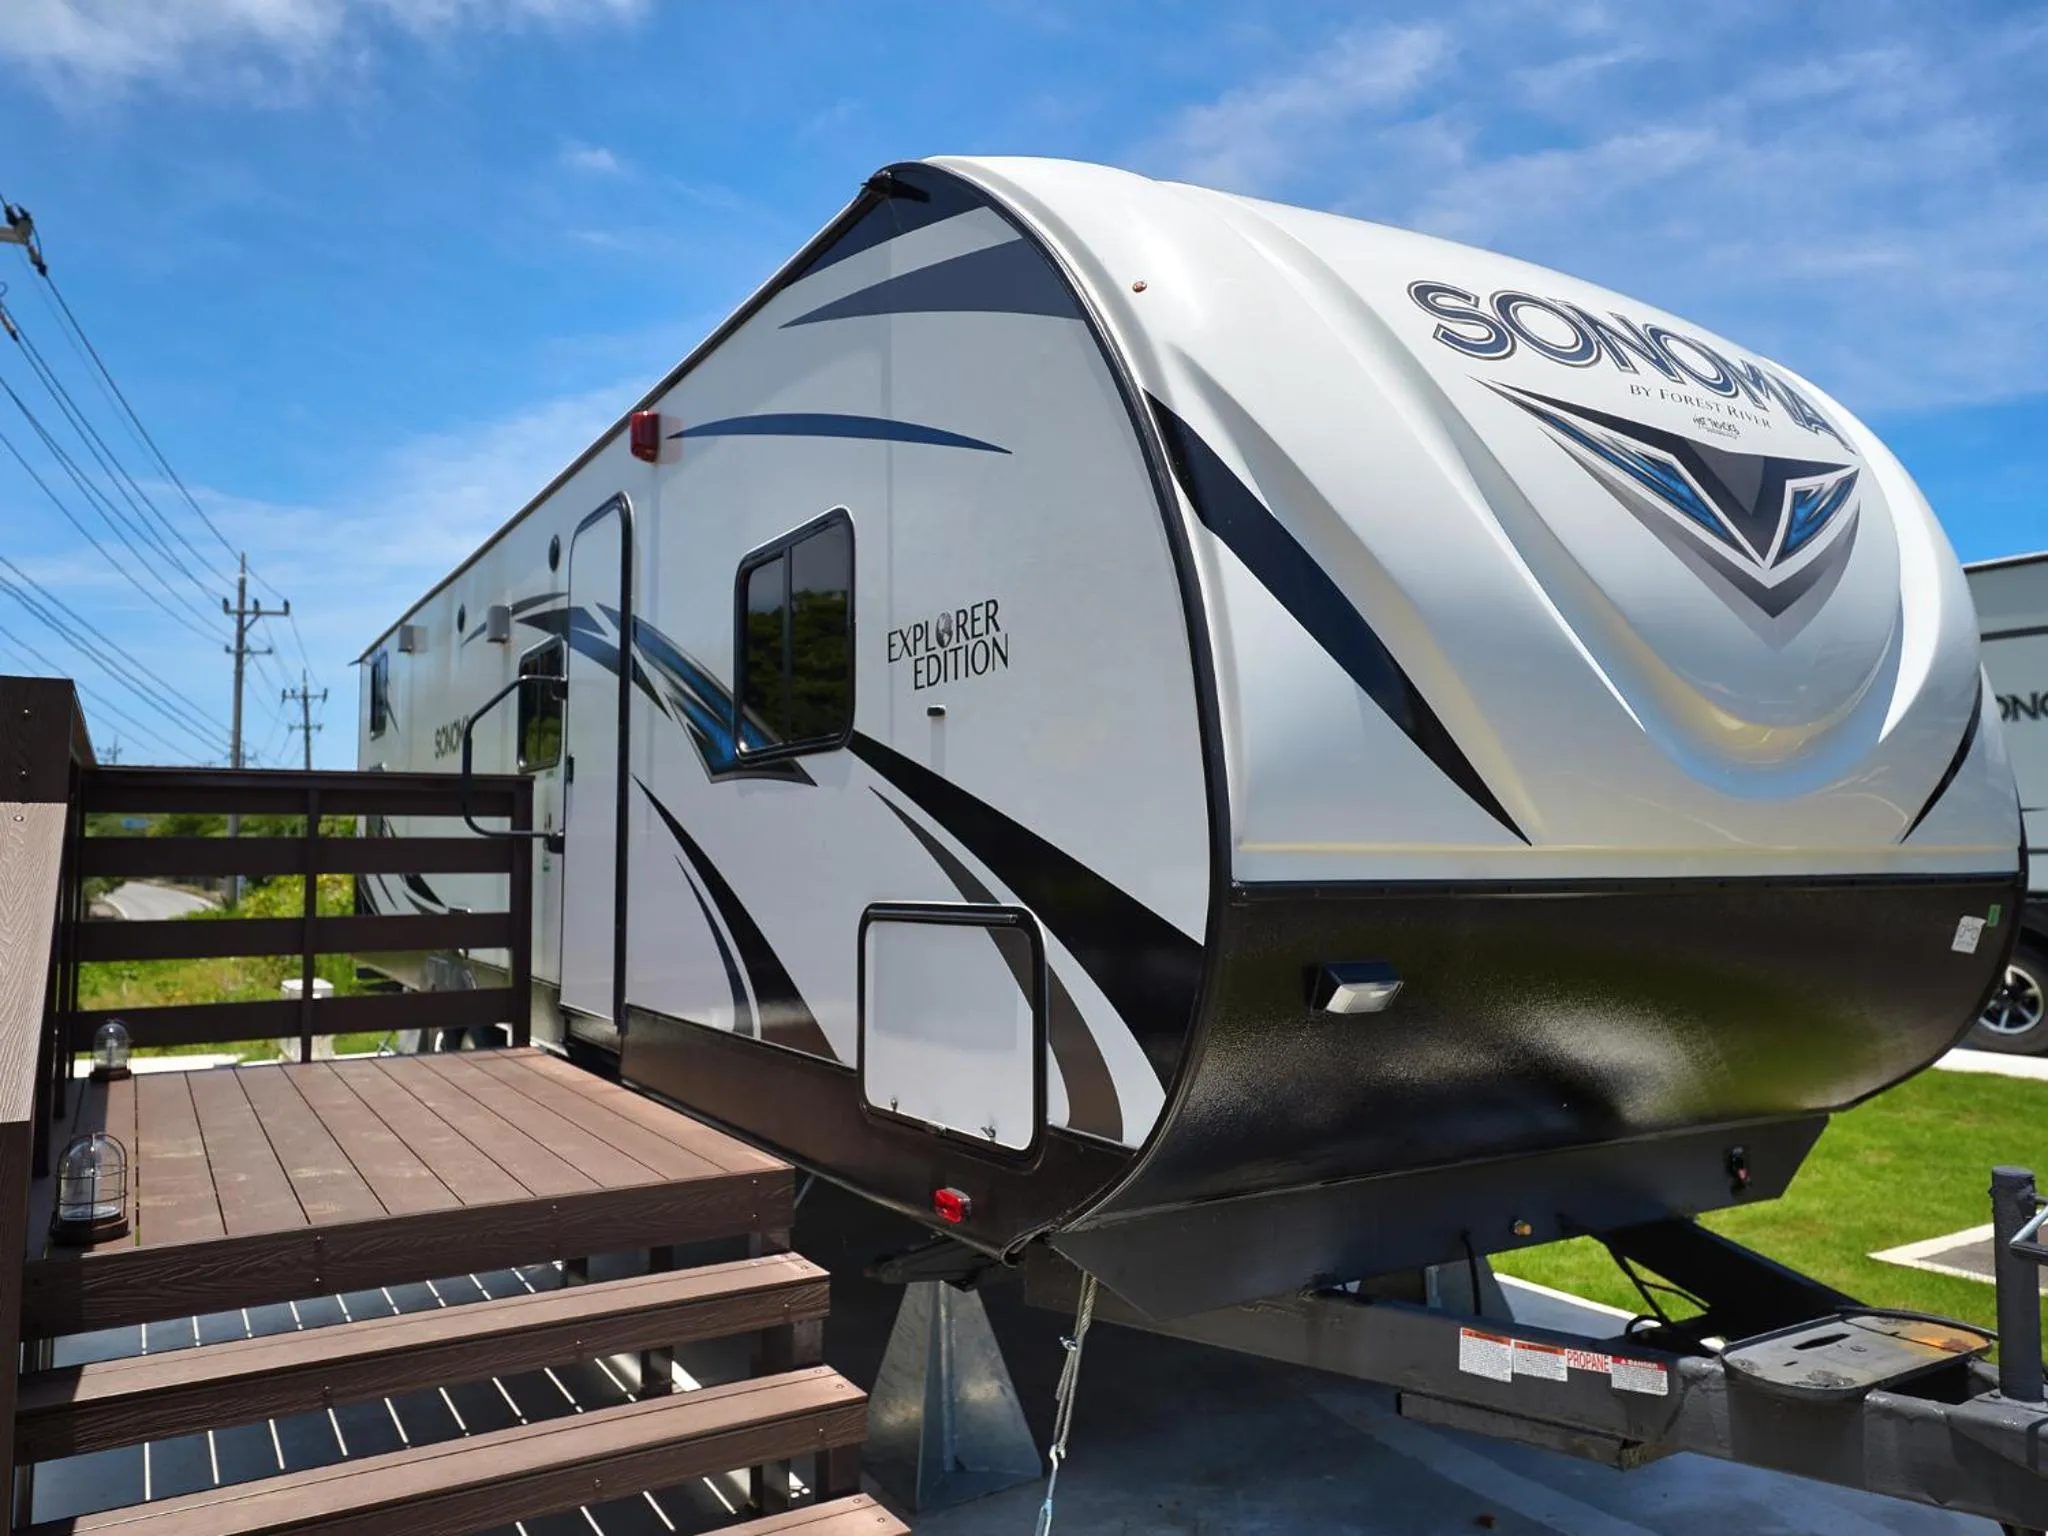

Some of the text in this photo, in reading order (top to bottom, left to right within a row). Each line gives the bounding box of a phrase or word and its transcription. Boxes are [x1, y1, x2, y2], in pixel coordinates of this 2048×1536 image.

[1407, 280, 1858, 456] SONOMA
[1630, 383, 1651, 397] BY
[1660, 388, 1722, 413] FOREST
[1727, 404, 1772, 429] RIVER
[888, 599, 1001, 663] EXPLORER
[914, 633, 1009, 690] EDITION
[1567, 1350, 1610, 1372] PROPANE
